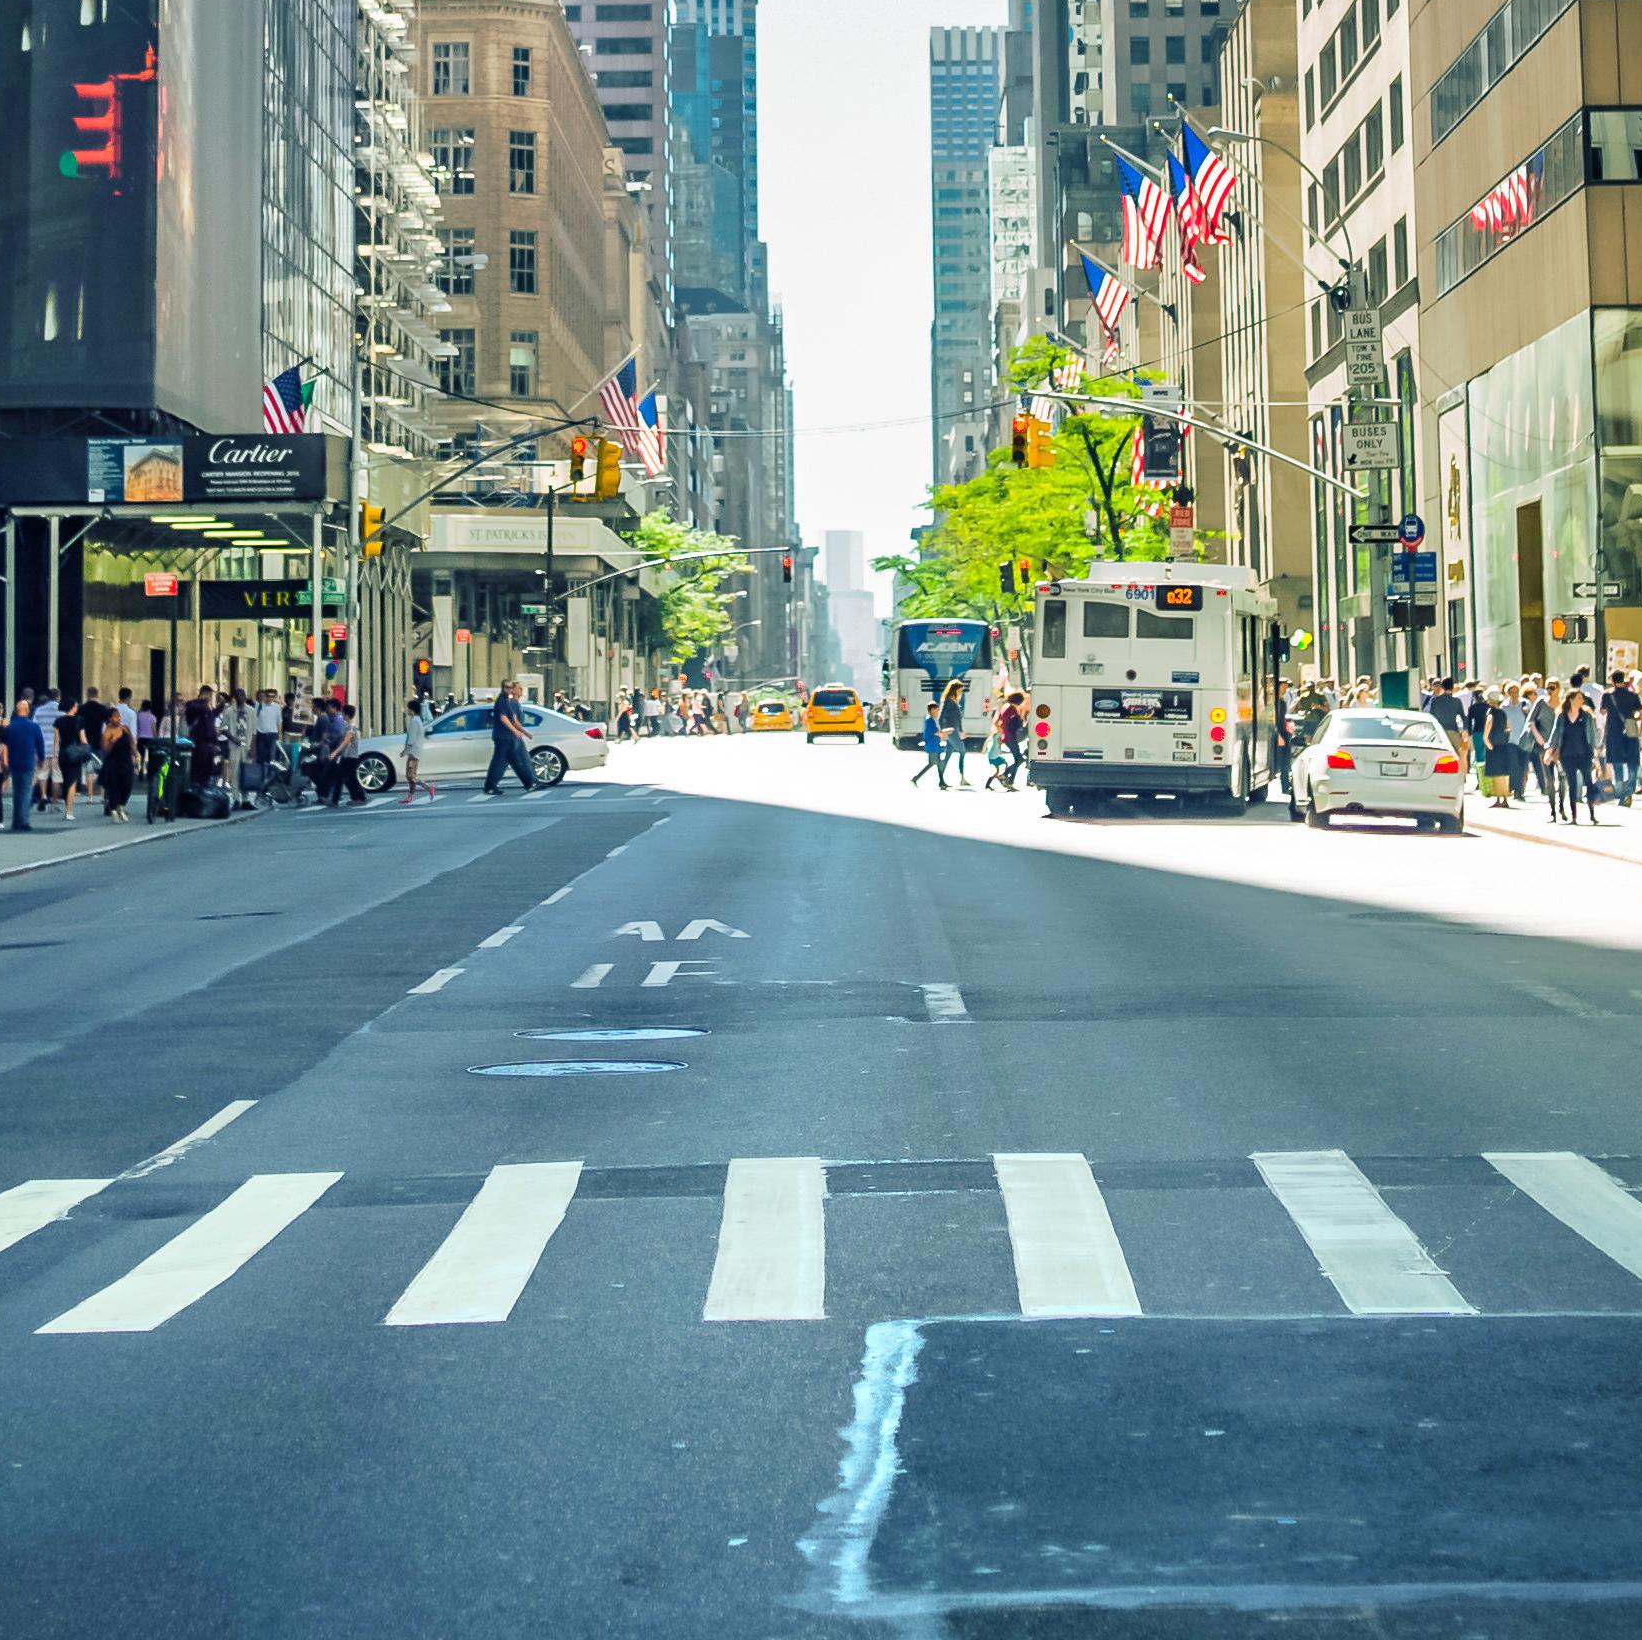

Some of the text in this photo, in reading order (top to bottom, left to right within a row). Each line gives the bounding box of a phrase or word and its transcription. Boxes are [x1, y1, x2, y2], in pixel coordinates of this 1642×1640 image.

[1352, 313, 1372, 325] BUS
[1350, 328, 1376, 339] LANE
[1352, 426, 1387, 437] BUSES
[1356, 439, 1383, 449] ONLY
[208, 438, 293, 464] Cartier
[1381, 529, 1398, 537] WAY
[244, 591, 292, 608] VER
[1125, 589, 1155, 600] 6901
[916, 642, 976, 653] ACADEMY
